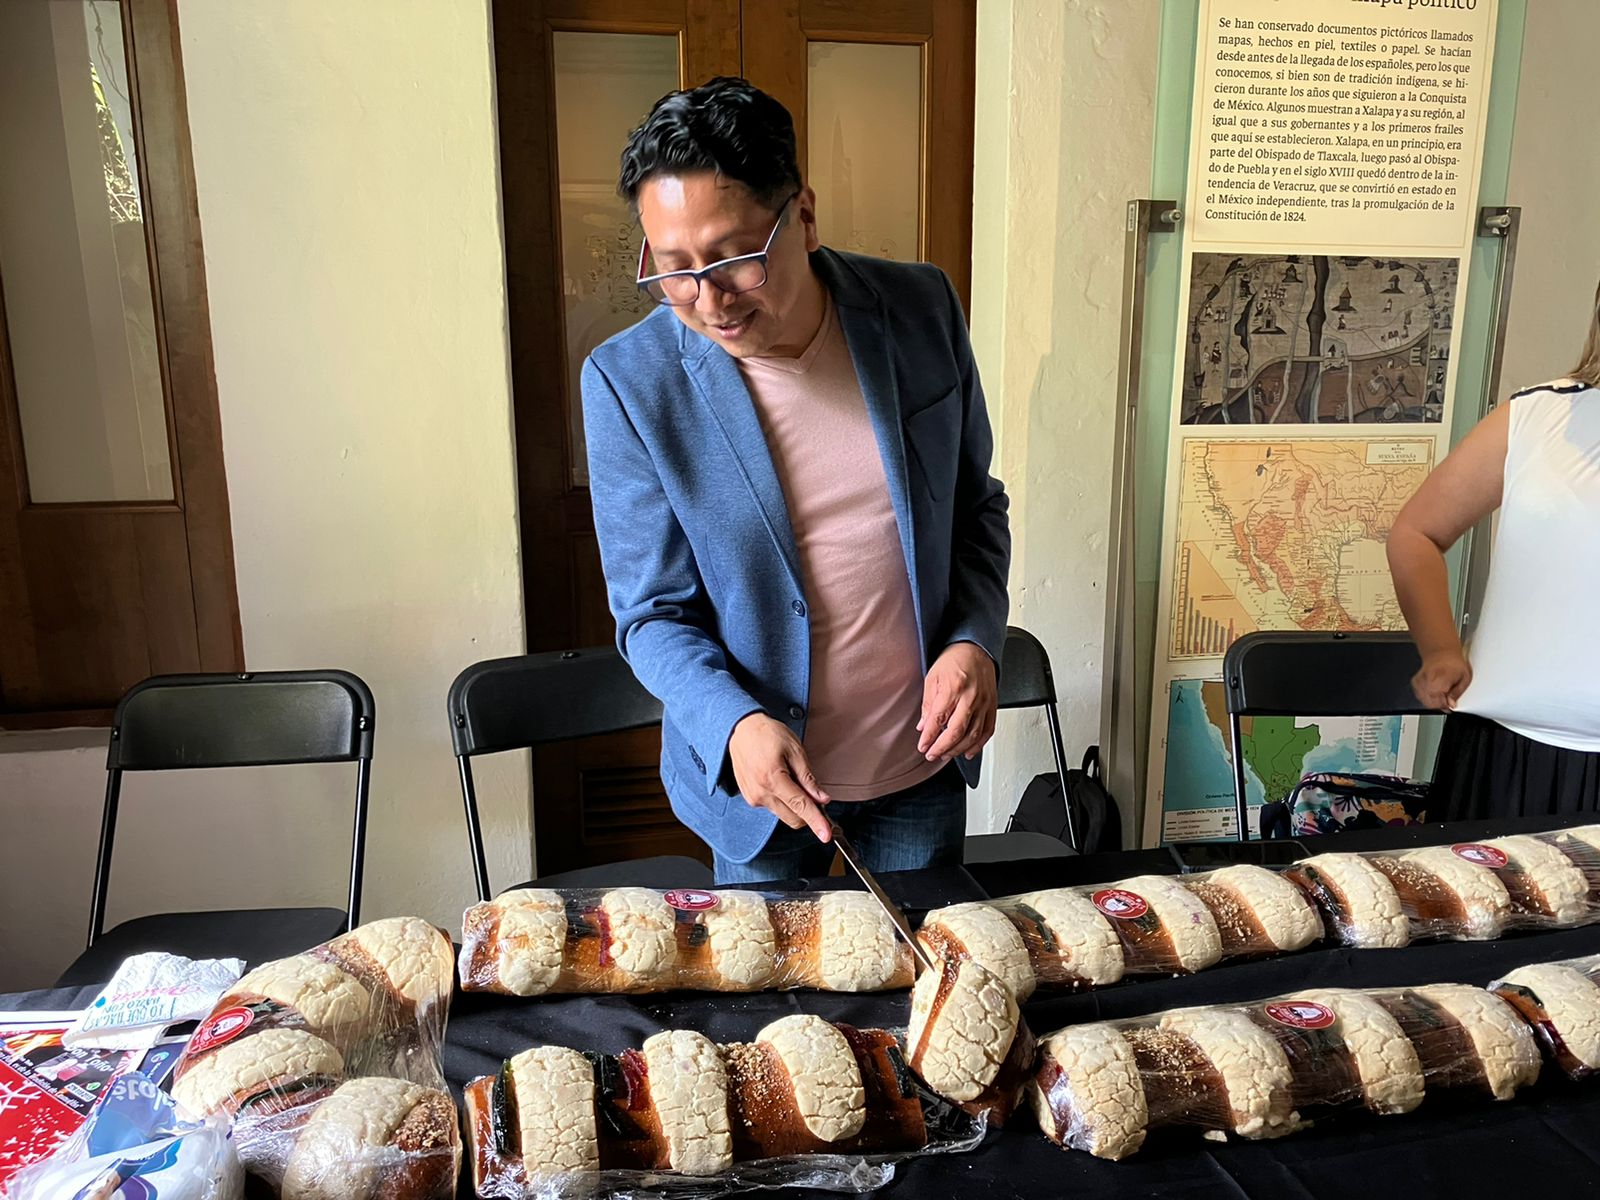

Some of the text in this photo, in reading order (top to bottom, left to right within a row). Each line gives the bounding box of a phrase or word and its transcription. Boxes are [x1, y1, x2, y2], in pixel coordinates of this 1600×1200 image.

[1219, 17, 1473, 41] Se han conservado documentos pictóricos llamados
[1218, 35, 1471, 57] mapas, hechos en piel, textiles o papel. Se hacían
[1216, 50, 1470, 74] desde antes de la llegada de los españoles, pero los que
[1215, 69, 1273, 80] conocemos,
[1275, 69, 1284, 80] si
[1288, 69, 1310, 81] bien
[1312, 73, 1330, 82] son
[1333, 71, 1346, 83] de
[1349, 73, 1392, 85] tradición
[1442, 79, 1452, 88] se
[1455, 78, 1468, 88] hi-
[1214, 82, 1245, 94] cieron
[1248, 84, 1288, 96] durante
[1290, 86, 1304, 97] los
[1306, 87, 1330, 98] años
[1332, 90, 1350, 100] que
[1352, 88, 1397, 102] siguieron
[1408, 91, 1417, 102] la
[1419, 92, 1466, 105] Conquista
[1213, 98, 1225, 109] de
[1266, 101, 1306, 114] Algunos
[1307, 105, 1353, 114] muestran
[1362, 105, 1394, 118] Xalapa
[1410, 109, 1421, 117] su
[1422, 108, 1454, 120] región,
[1456, 109, 1465, 119] al
[1212, 115, 1236, 127] igual
[1240, 119, 1258, 128] que
[1271, 120, 1287, 128] sus
[1290, 118, 1350, 130] gobernantes
[1362, 123, 1368, 131] a
[1371, 121, 1386, 132] los
[1388, 122, 1432, 134] primeros
[1434, 123, 1464, 134] frailes
[1211, 133, 1229, 143] que
[1231, 132, 1252, 144] aquí
[1254, 135, 1265, 143] se
[1335, 136, 1370, 148] Xalapa,
[1372, 139, 1384, 147] en
[1386, 139, 1399, 148] un
[1401, 138, 1445, 151] principio,
[1210, 147, 1460, 167] parte del Obispado de Tlaxcala, luego pasó al Obispa-
[1208, 162, 1221, 173] do
[1222, 162, 1235, 173] de
[1237, 163, 1270, 174] Puebla
[1279, 167, 1292, 175] en
[1293, 165, 1302, 176] el
[1304, 165, 1327, 178] siglo
[1328, 167, 1355, 177] XVIII
[1356, 168, 1386, 180] quedó
[1387, 168, 1420, 179] dentro
[1421, 169, 1432, 179] de
[1434, 169, 1443, 180] la
[1445, 170, 1458, 180] in-
[1208, 178, 1256, 190] tendencia
[1258, 179, 1270, 190] de
[1273, 180, 1317, 192] Veracruz,
[1319, 184, 1337, 194] que
[1339, 184, 1350, 192] se
[1352, 183, 1395, 194] convirtió
[1397, 186, 1409, 194] en
[1411, 184, 1442, 195] estado
[1206, 193, 1454, 211] el México independiente, tras la promulgación de la
[1205, 209, 1306, 222] Constitución de 1824.
